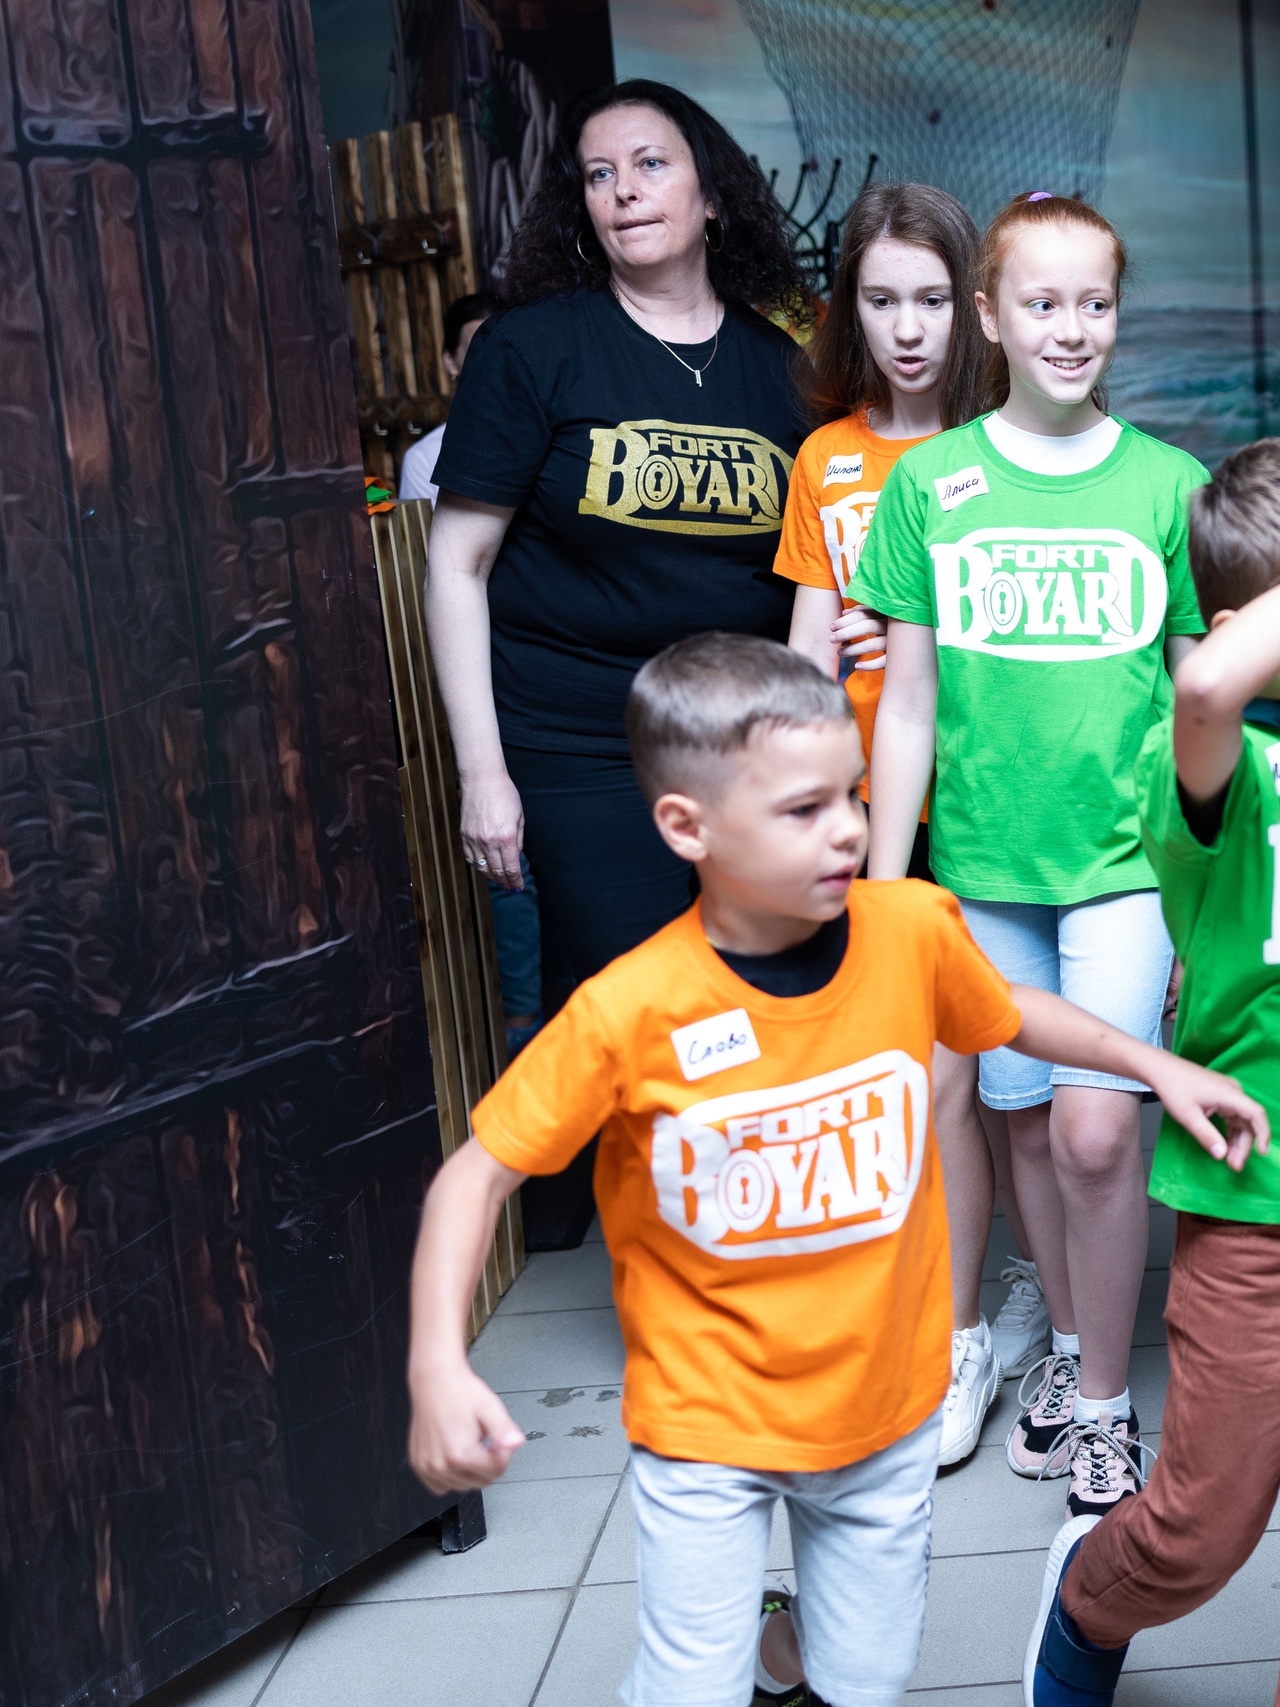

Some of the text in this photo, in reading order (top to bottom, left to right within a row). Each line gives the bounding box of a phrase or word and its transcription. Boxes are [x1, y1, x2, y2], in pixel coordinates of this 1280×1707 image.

[649, 432, 747, 460] FORT
[941, 478, 979, 500] Алиса
[992, 544, 1103, 569] FORT
[929, 542, 1167, 650] BOYARD
[726, 1081, 874, 1148] FORT
[651, 1060, 929, 1246] BOYARD
